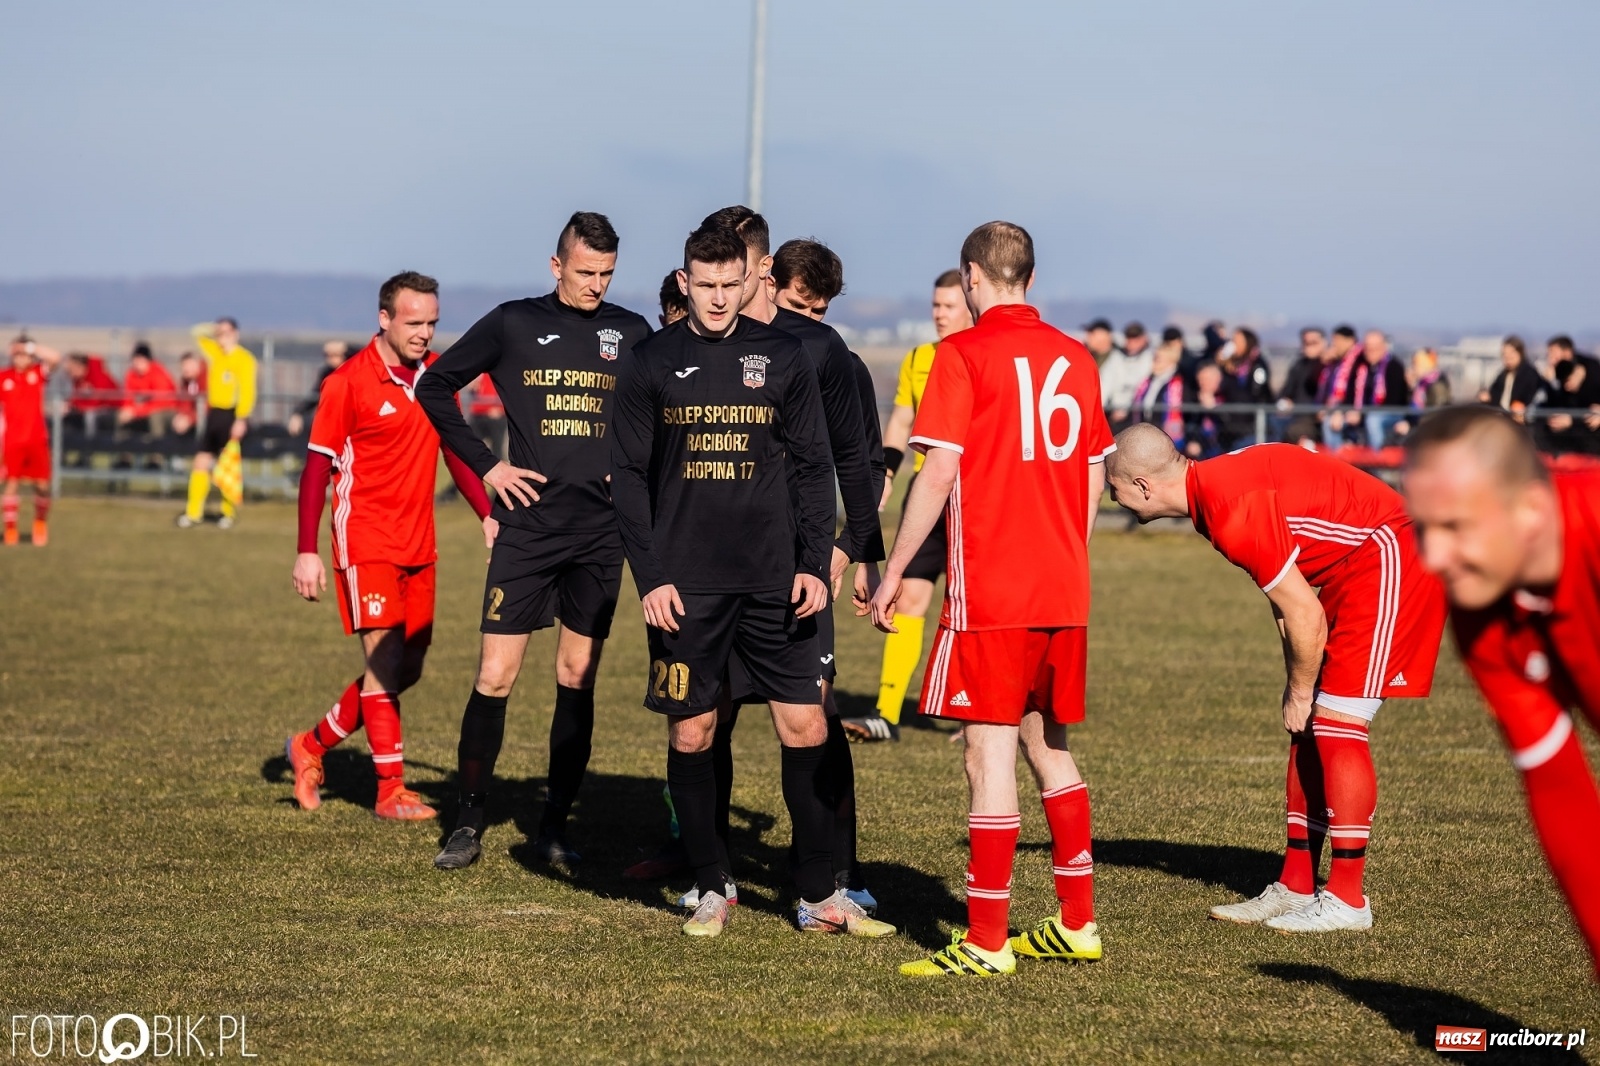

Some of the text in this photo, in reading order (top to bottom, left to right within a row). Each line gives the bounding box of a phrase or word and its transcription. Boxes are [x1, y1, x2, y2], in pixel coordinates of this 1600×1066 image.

[602, 344, 616, 355] KS
[523, 369, 616, 391] SKLEP SPORTOW
[746, 371, 762, 381] KS
[546, 392, 603, 413] RACIBÓRZ
[1013, 355, 1082, 461] 16
[663, 405, 774, 424] SKLEP SPORTOWY
[540, 419, 606, 438] CHOPINA 17
[686, 430, 750, 452] RACIBÓRZ
[739, 461, 755, 480] 17
[368, 600, 382, 616] 10
[486, 586, 505, 621] 2
[653, 659, 690, 701] 20
[949, 699, 972, 707] adidas
[1067, 857, 1093, 865] adida
